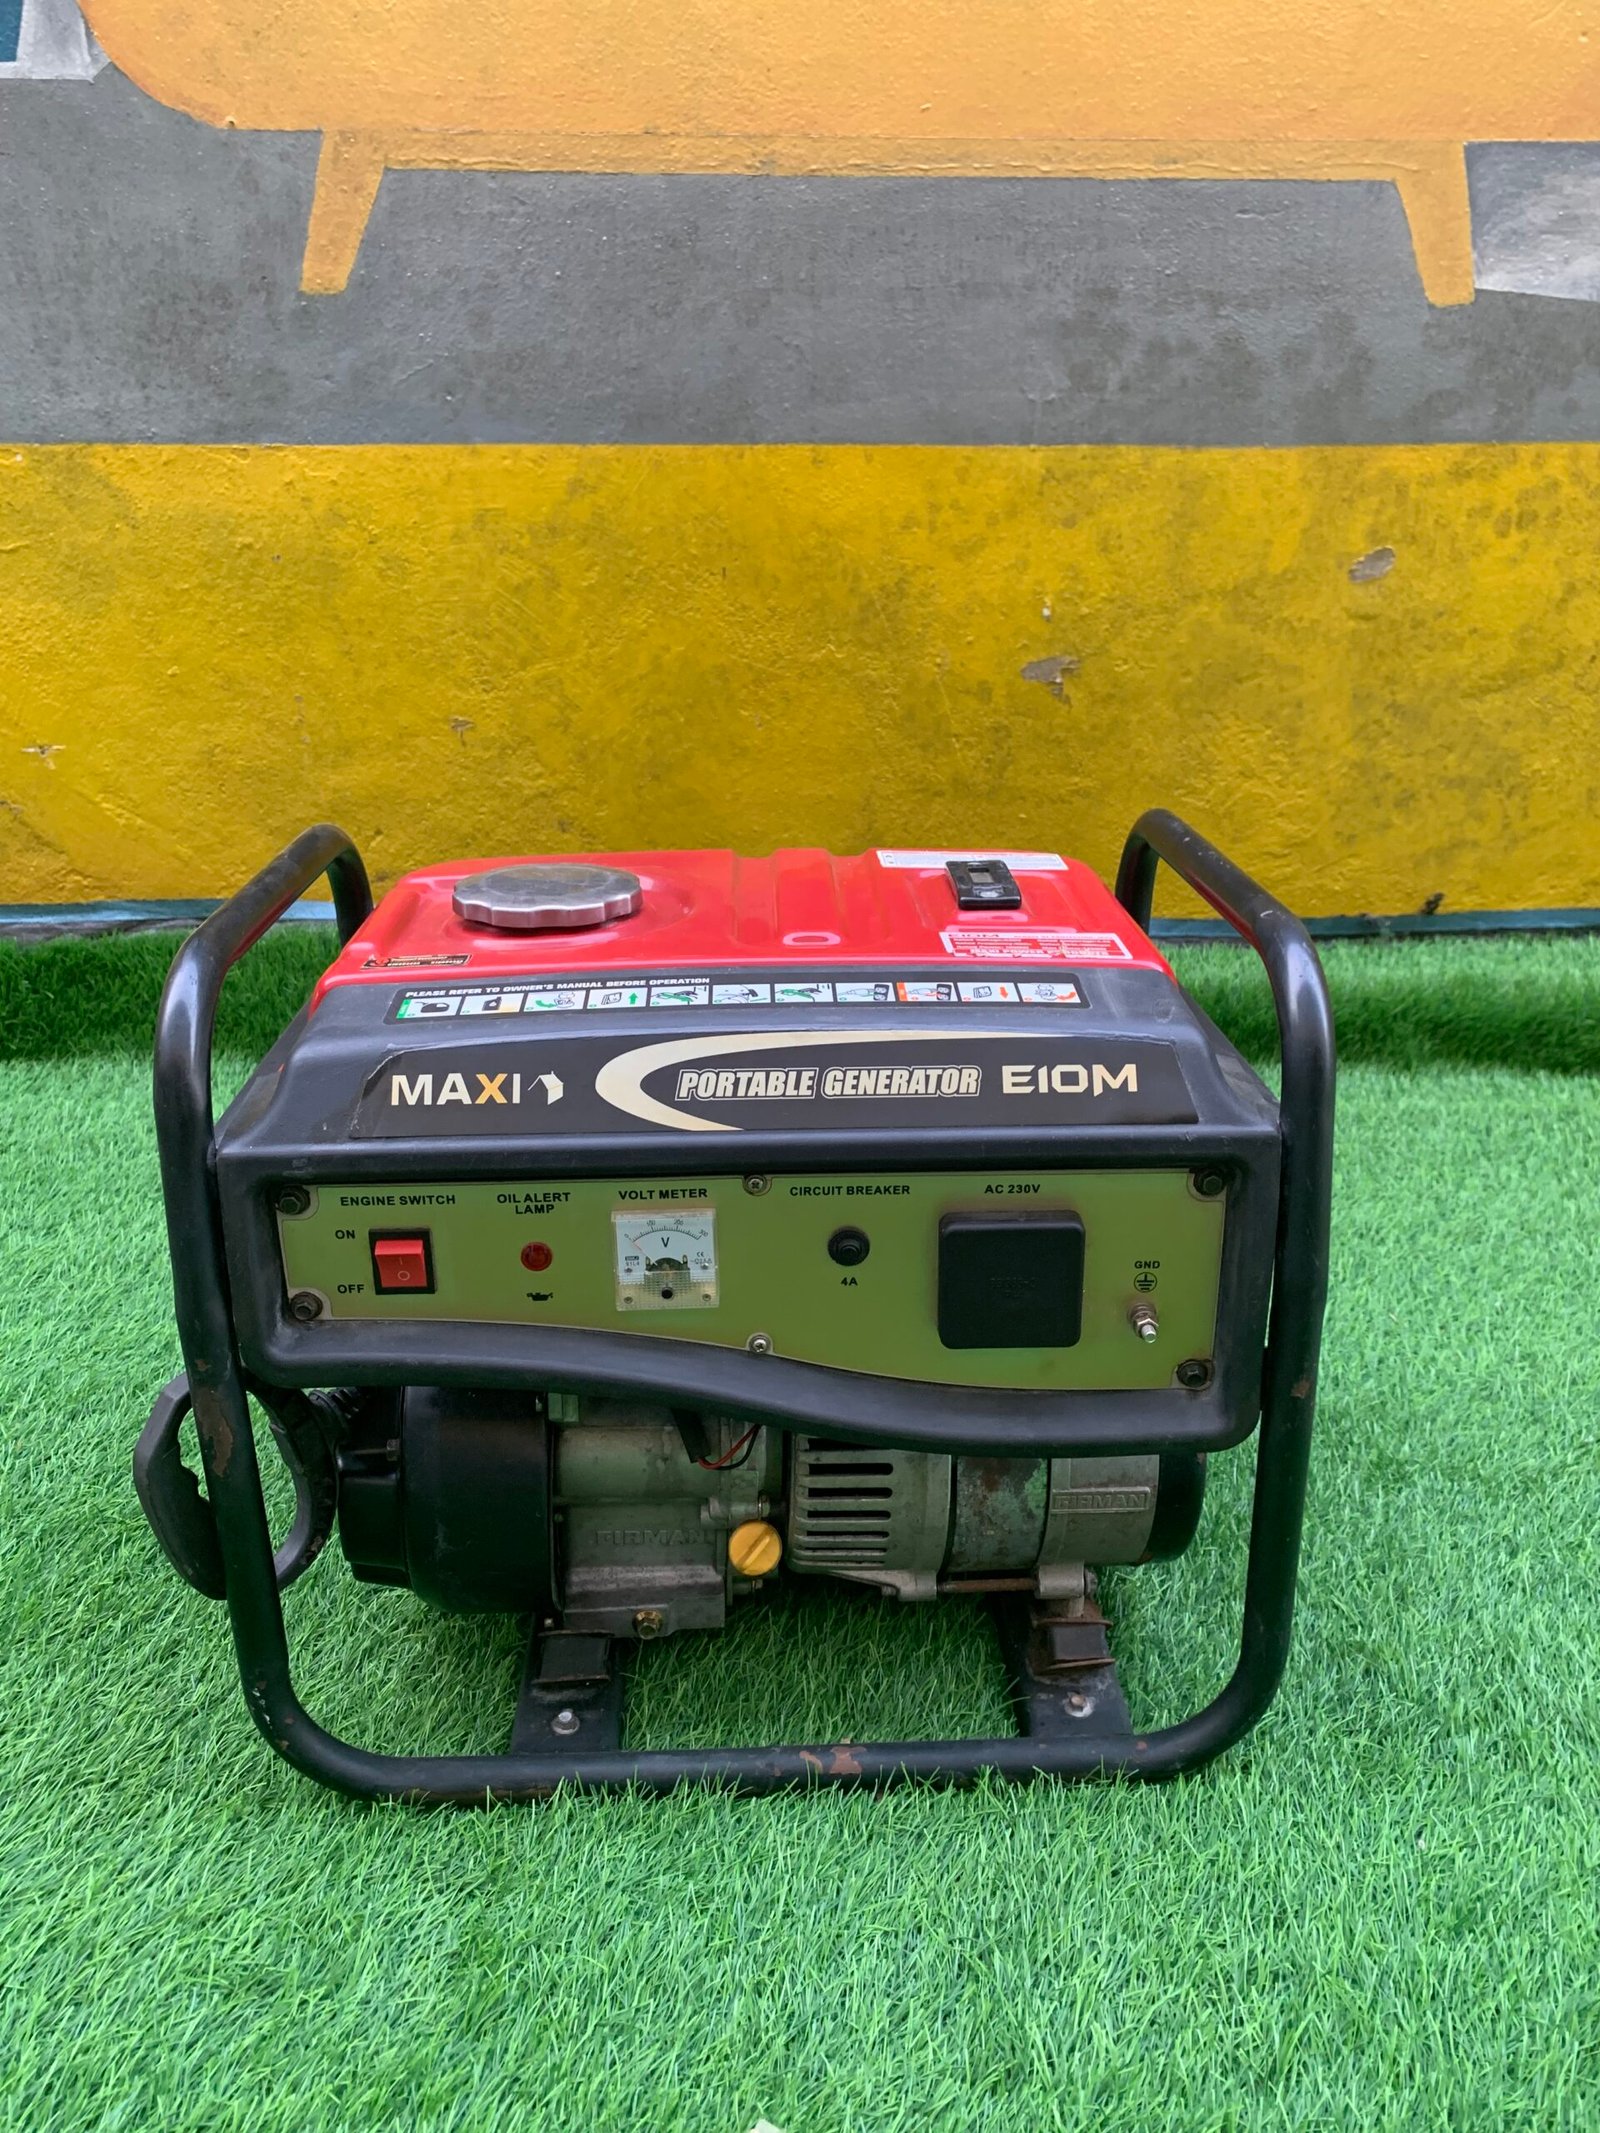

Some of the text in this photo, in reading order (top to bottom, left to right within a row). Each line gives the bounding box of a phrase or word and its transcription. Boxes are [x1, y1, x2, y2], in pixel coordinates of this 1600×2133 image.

[503, 984, 553, 992] OWNER'S
[557, 981, 603, 989] MANUAL
[676, 1066, 982, 1100] PORTABLE GENERATOR
[391, 1073, 521, 1106] MAXI
[618, 1188, 708, 1200] VOLT METER
[790, 1185, 911, 1196] CIRCUIT BREAKER
[984, 1183, 1041, 1194] AC 230V
[340, 1194, 456, 1206] ENGINE SWITCH
[497, 1192, 571, 1204] OIL ALERT
[515, 1204, 555, 1214] LAMP
[335, 1230, 355, 1240] ON
[661, 1237, 670, 1248] V
[1134, 1260, 1161, 1269] GND
[840, 1277, 858, 1286] 4A
[337, 1284, 365, 1294] OFF
[1054, 1494, 1145, 1510] FIRMAN
[595, 1529, 705, 1546] FIRMAN
